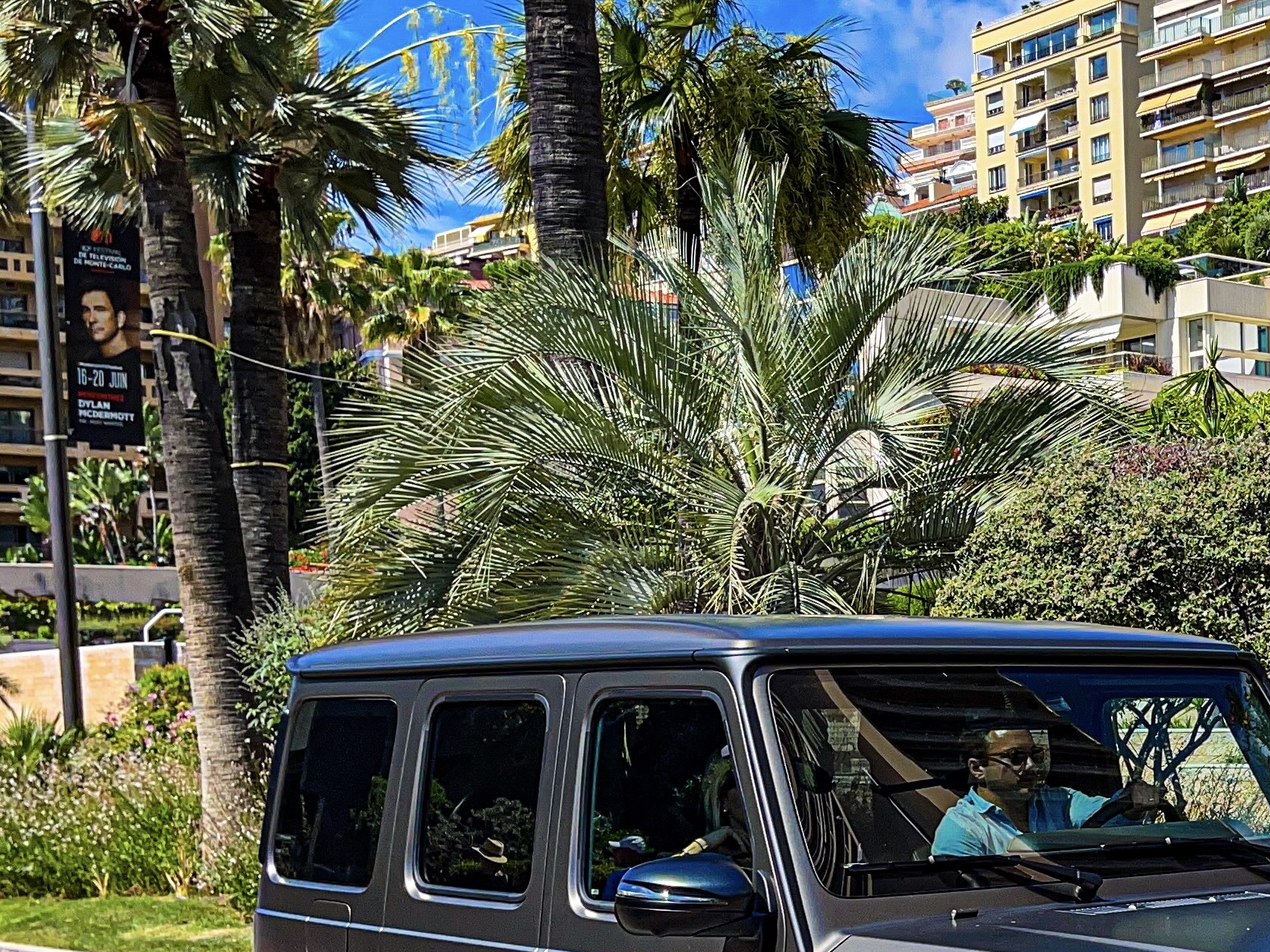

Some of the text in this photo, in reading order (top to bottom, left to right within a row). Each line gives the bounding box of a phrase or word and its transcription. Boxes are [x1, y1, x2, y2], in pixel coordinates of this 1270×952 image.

[73, 257, 132, 271] DE MONTE-CARLO
[77, 367, 128, 389] 16-20 JUIN
[78, 399, 111, 410] DYLAN
[78, 409, 135, 422] MCDERMOTT
